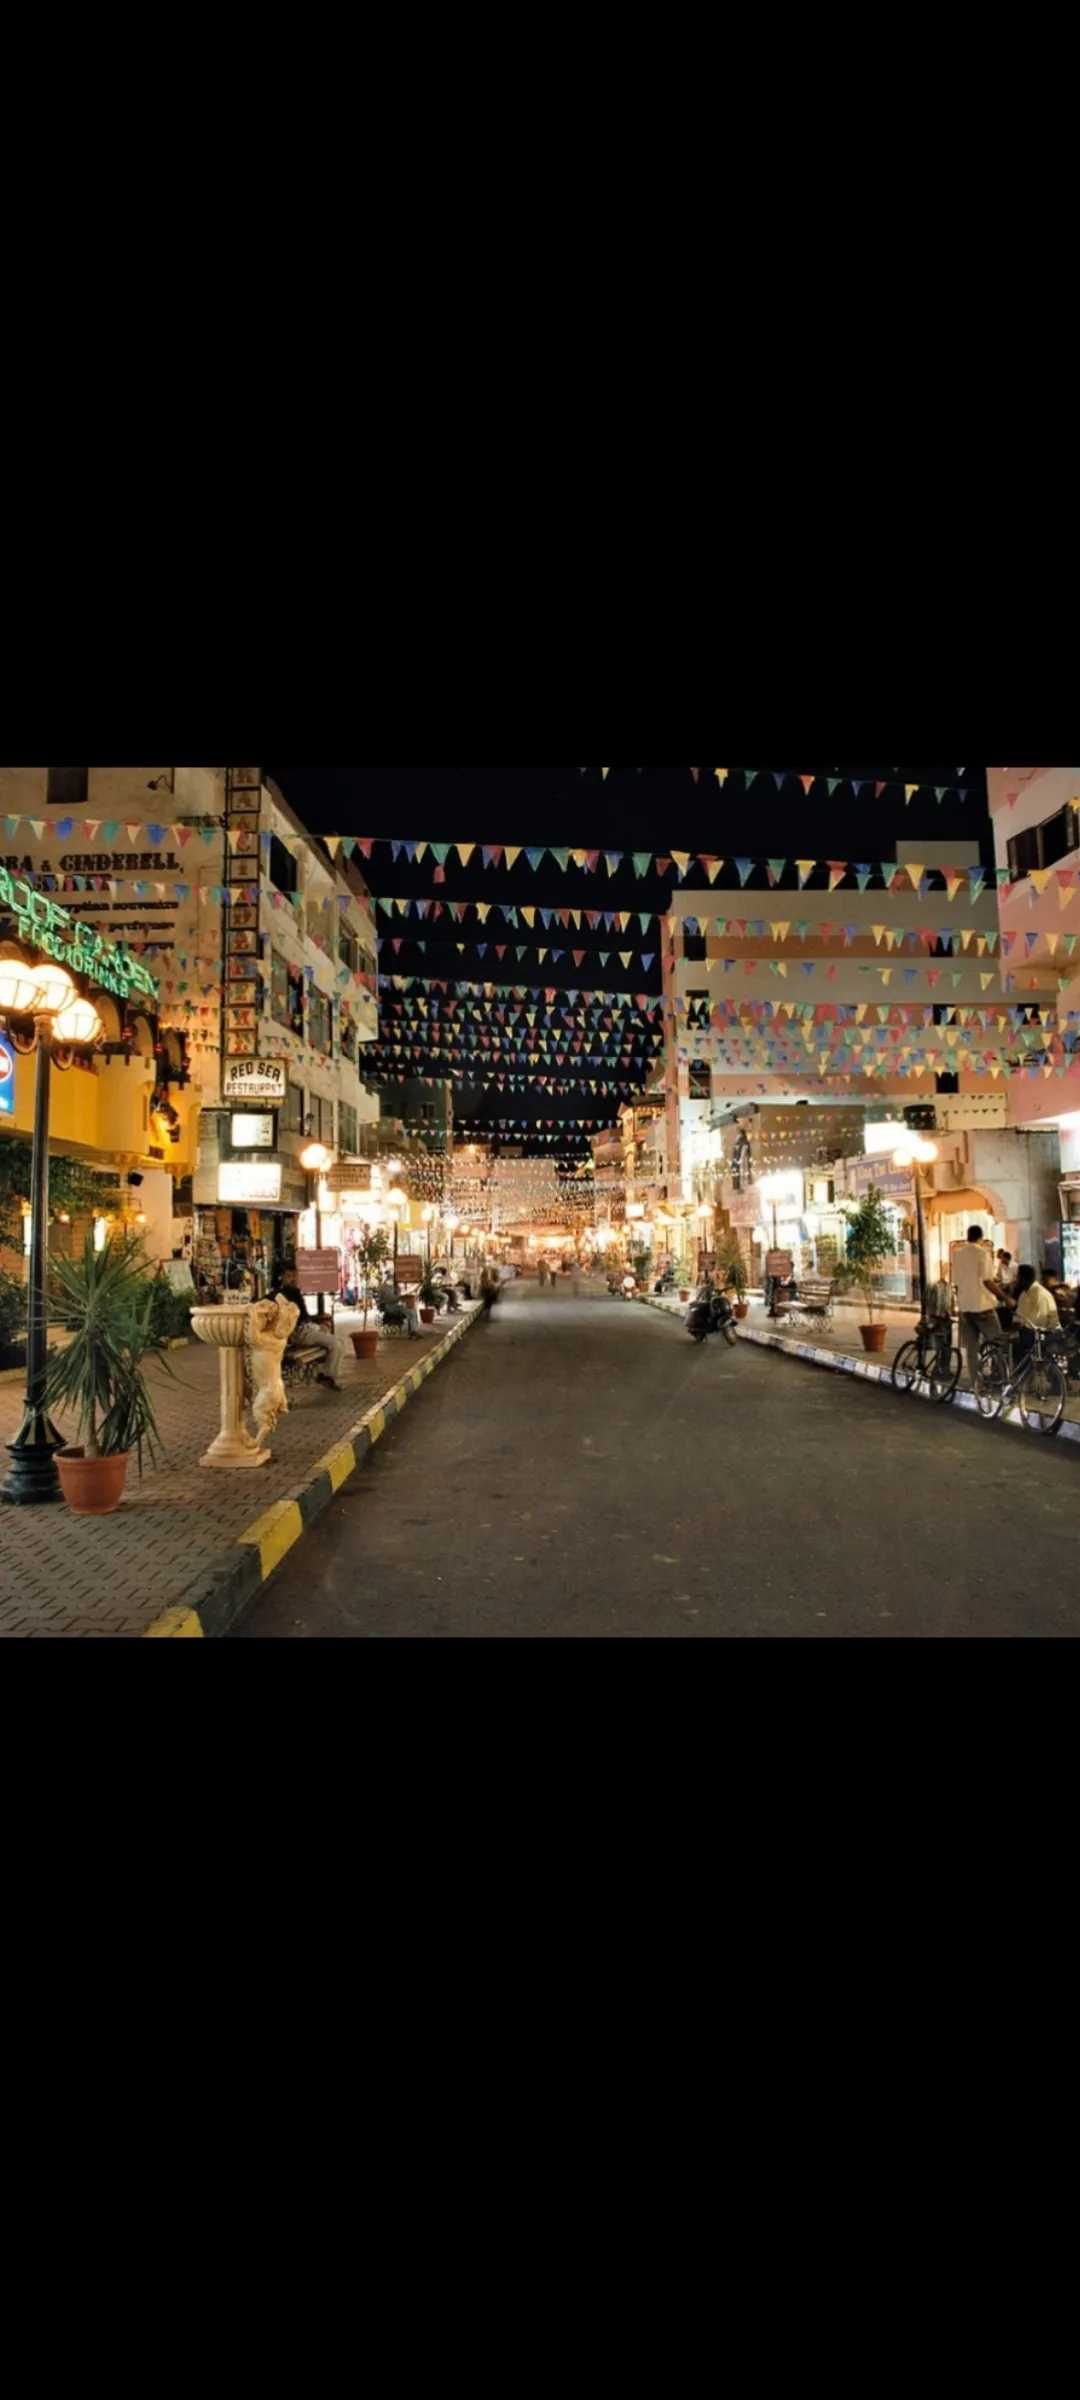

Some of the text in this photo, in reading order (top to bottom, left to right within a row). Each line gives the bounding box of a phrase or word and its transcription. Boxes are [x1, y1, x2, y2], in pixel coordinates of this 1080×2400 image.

[41, 860, 52, 872] &
[231, 1061, 281, 1082] RED SEA
